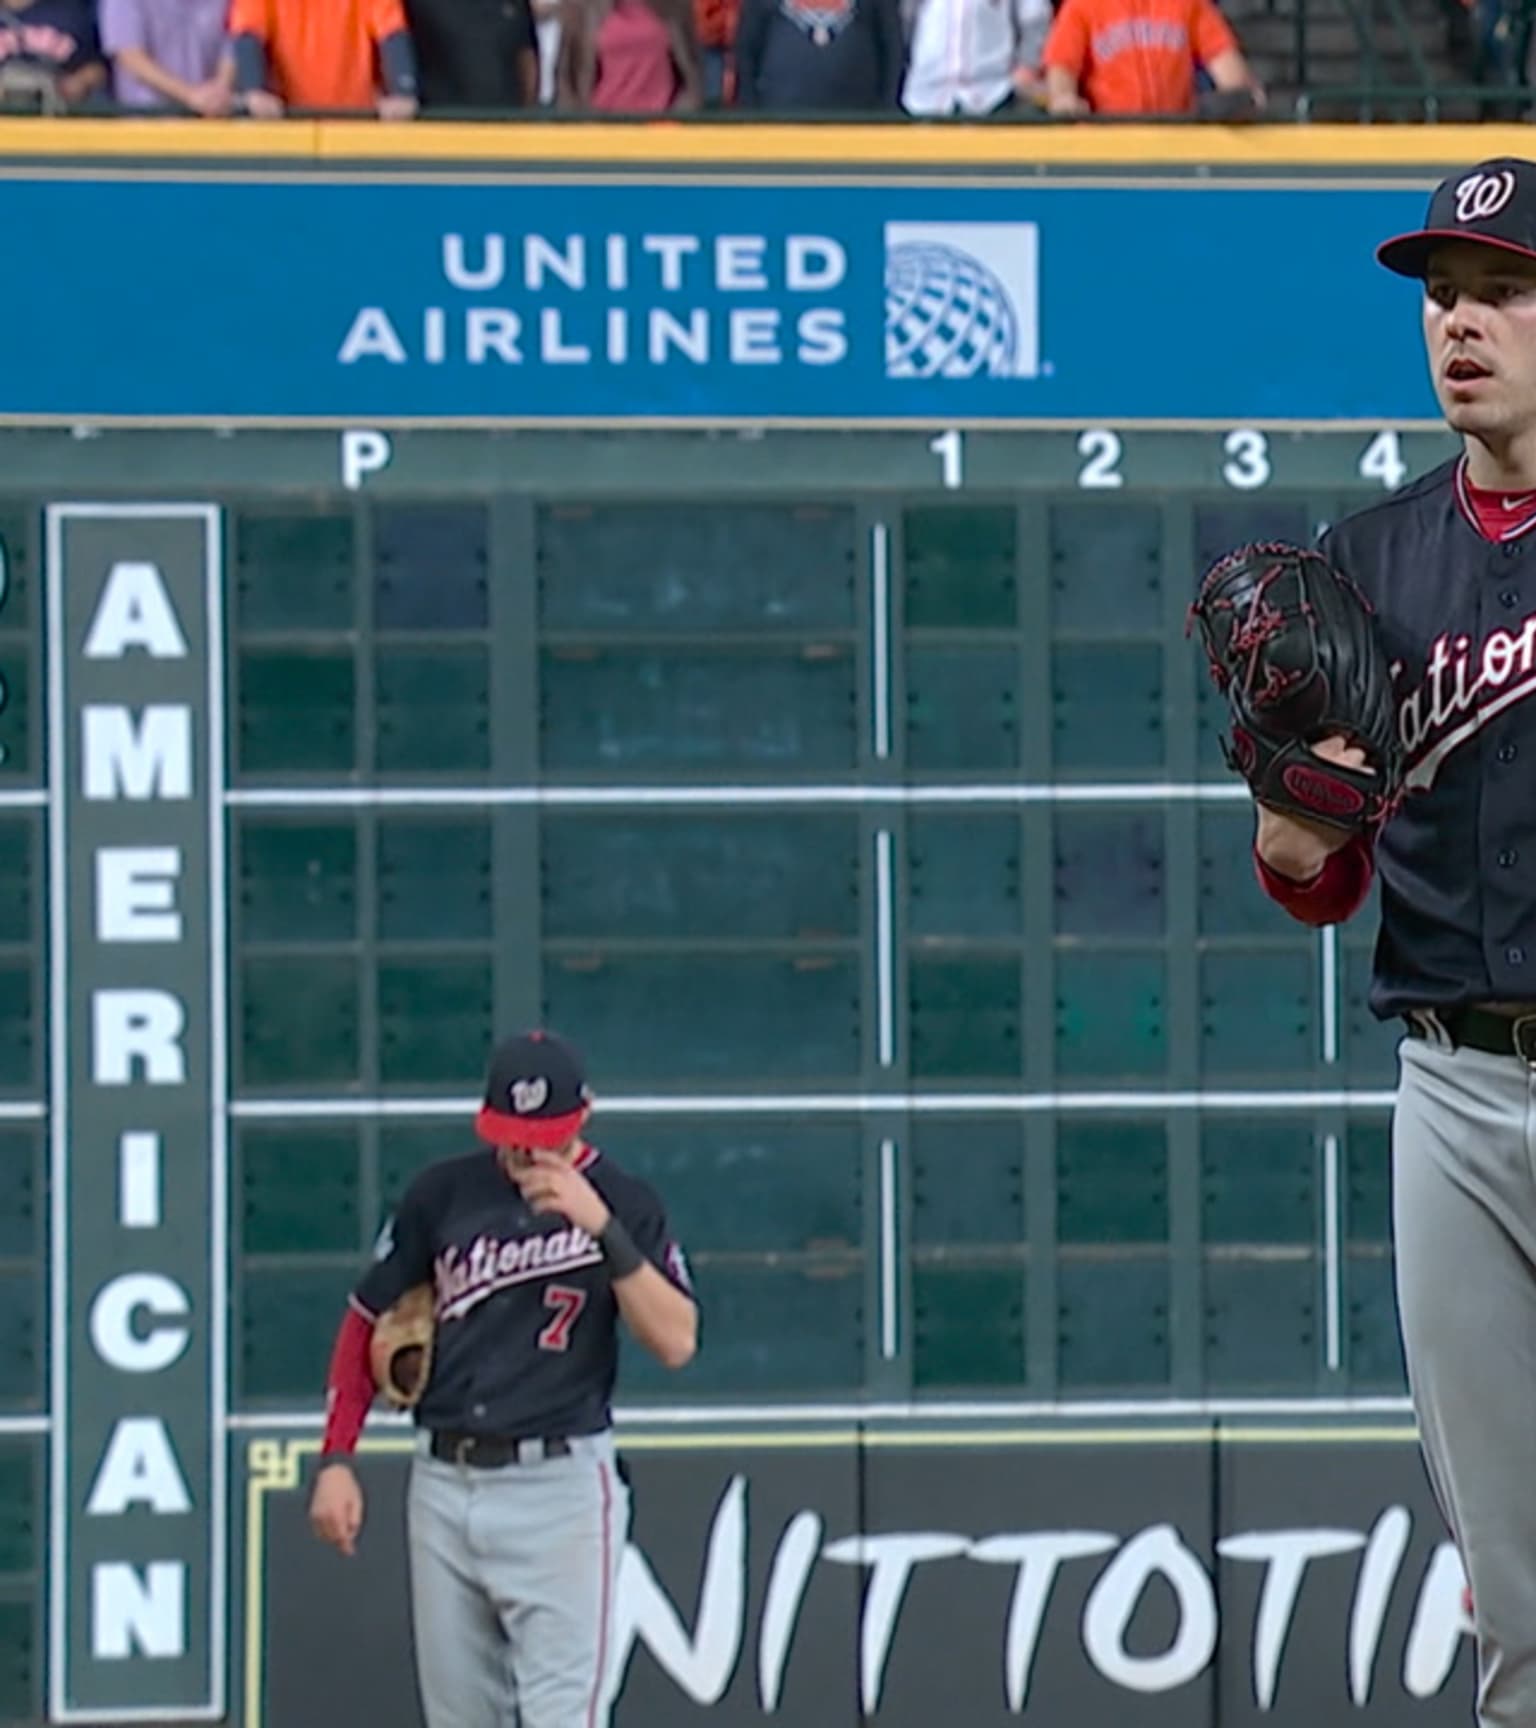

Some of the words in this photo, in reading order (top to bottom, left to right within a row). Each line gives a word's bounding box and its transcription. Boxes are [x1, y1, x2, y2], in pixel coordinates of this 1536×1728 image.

[1455, 169, 1516, 223] W
[441, 234, 848, 291] UNITED
[338, 308, 848, 365] AIRLINES
[341, 431, 391, 490] P
[930, 430, 964, 488] 1
[1077, 430, 1123, 488] 2
[1224, 430, 1271, 489] 3
[1359, 431, 1405, 489] 4
[81, 560, 193, 1659] AMERICAN
[538, 1284, 587, 1352] 7
